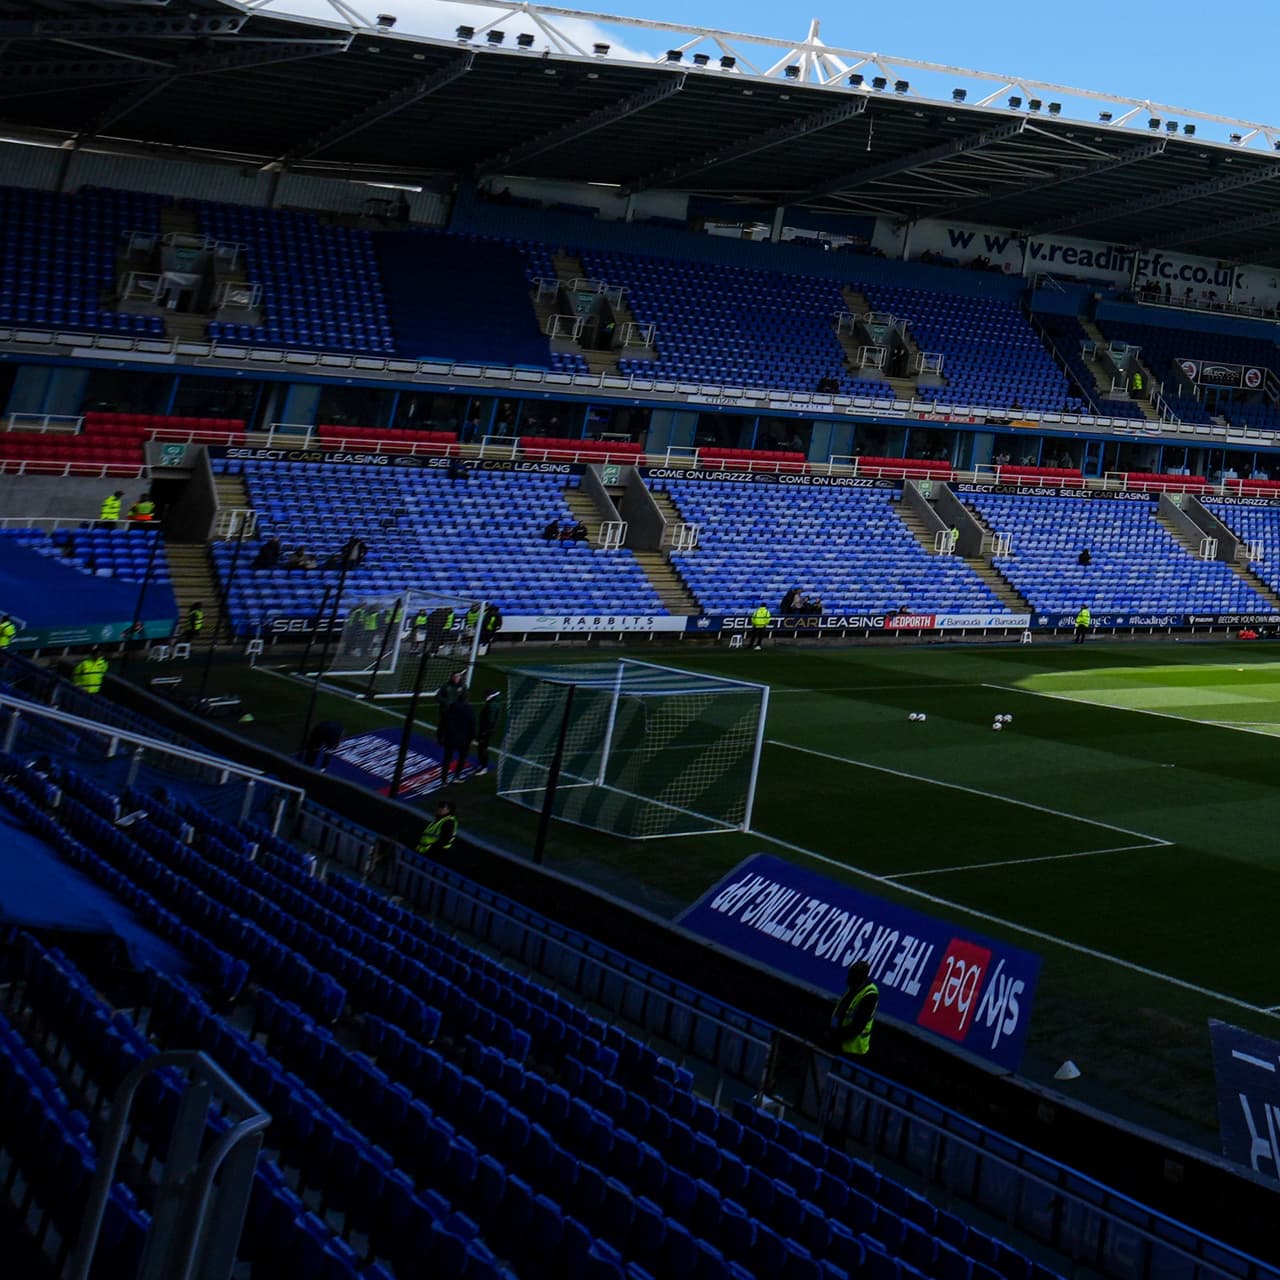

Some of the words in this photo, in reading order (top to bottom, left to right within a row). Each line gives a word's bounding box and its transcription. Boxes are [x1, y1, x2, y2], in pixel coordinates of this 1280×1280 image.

[225, 448, 287, 461] SELECT
[287, 451, 321, 462] CAR
[325, 452, 388, 465] LEASING
[427, 458, 480, 470] SELCT
[482, 460, 512, 471] CAR
[514, 461, 571, 473] LEASING
[649, 469, 683, 481] COME
[685, 470, 703, 481] ON
[778, 474, 808, 485] COME
[810, 476, 826, 486] ON
[958, 484, 993, 494] SELECT
[1017, 486, 1056, 497] LEASING
[1059, 488, 1093, 498] SELECT
[1114, 491, 1150, 501] LEASING
[1200, 496, 1223, 505] COME
[1224, 496, 1236, 505] ON
[563, 617, 653, 625] RABBITS
[1129, 615, 1177, 627] #ReadingFC
[710, 872, 766, 917] APP
[740, 882, 831, 947] BETTING
[882, 934, 935, 997] THE
[932, 955, 981, 1031] bet
[976, 958, 1025, 1050] sky
